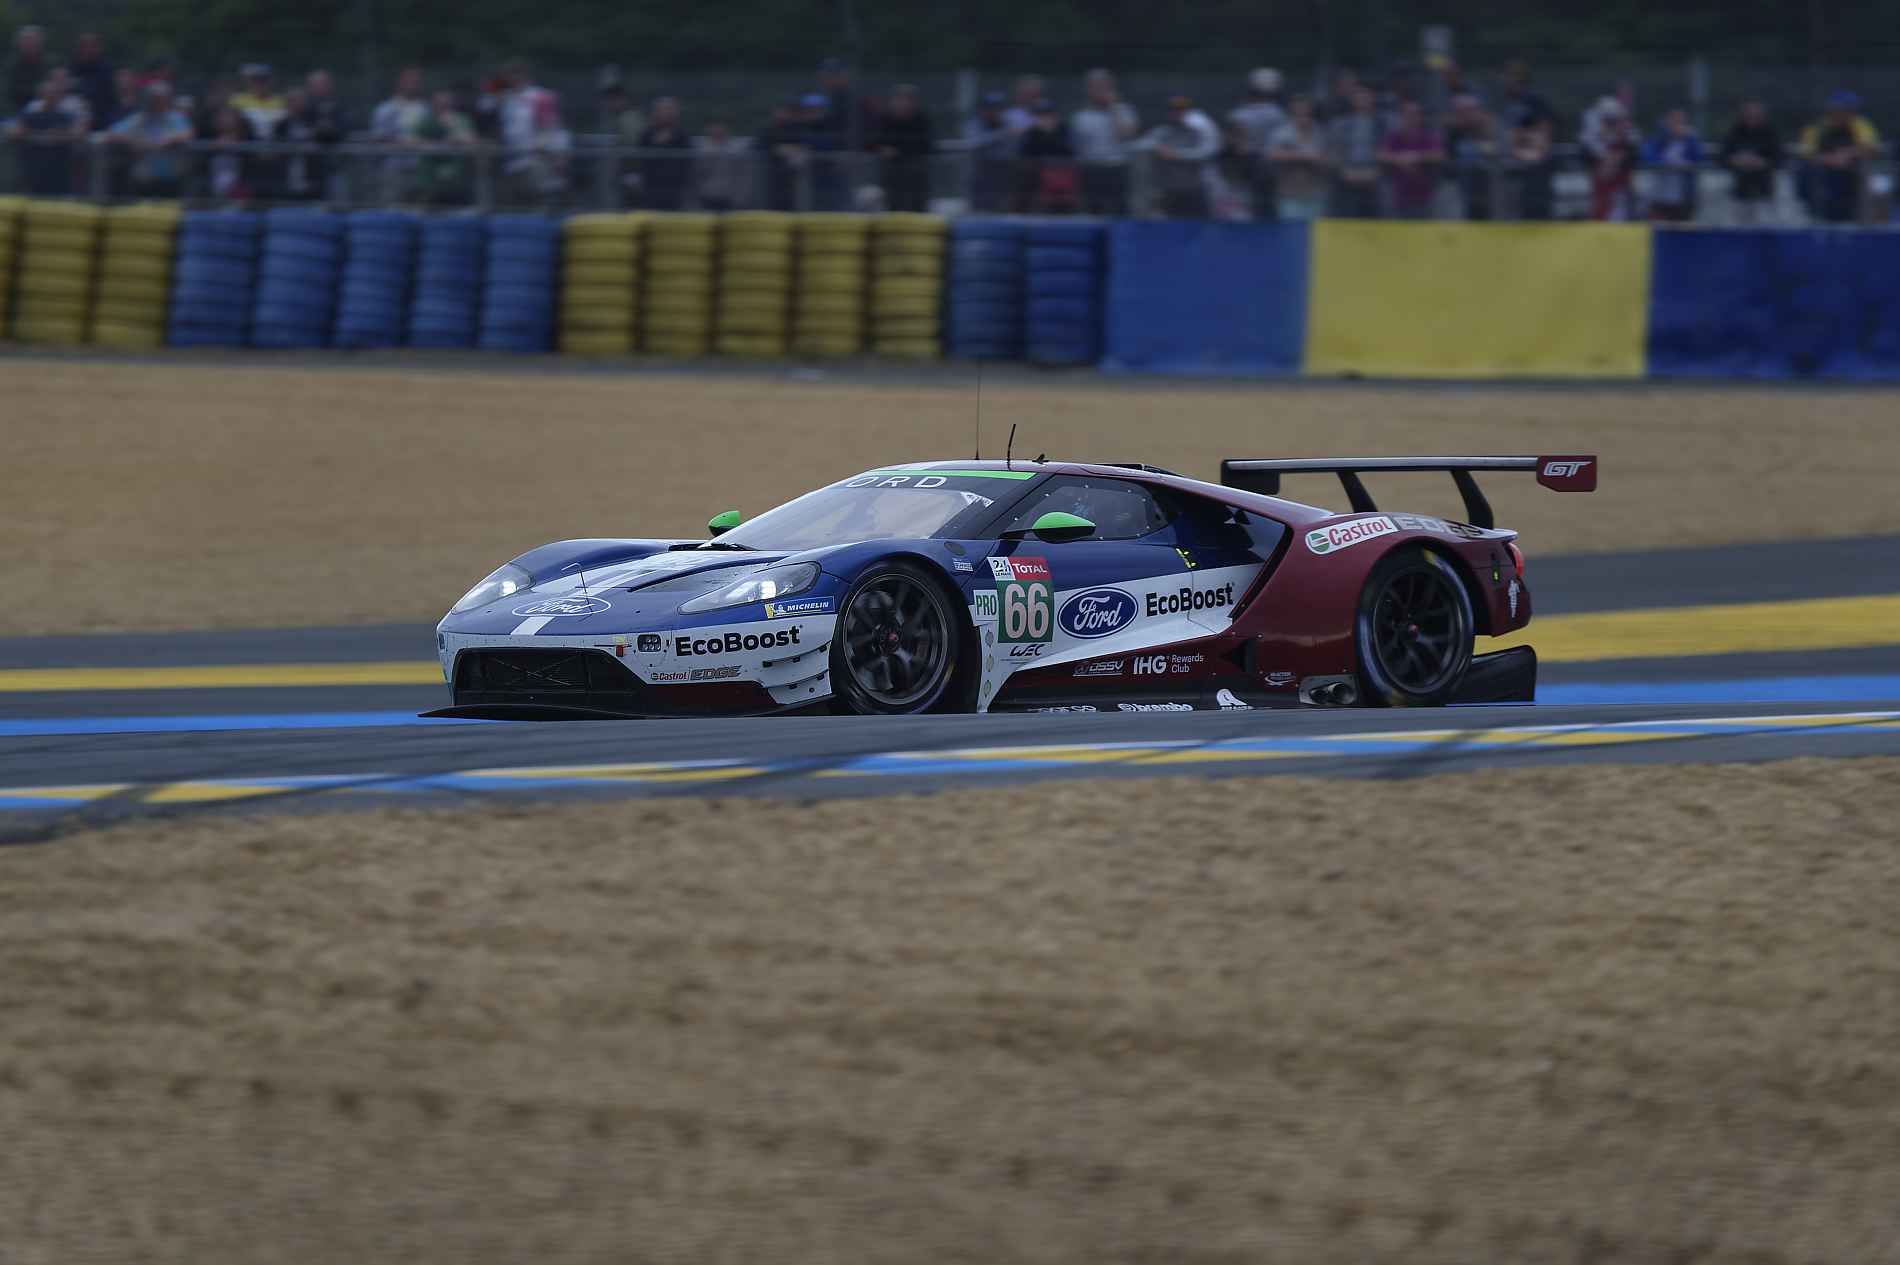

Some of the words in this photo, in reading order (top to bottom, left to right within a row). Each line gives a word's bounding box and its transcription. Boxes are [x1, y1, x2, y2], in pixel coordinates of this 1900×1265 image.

[1543, 460, 1592, 477] GT
[1328, 518, 1393, 546] Castrol
[1012, 563, 1048, 574] TOTAL
[786, 601, 830, 612] MICHELIN
[975, 594, 997, 616] PRO
[1004, 583, 1050, 638] 66
[1146, 582, 1234, 617] EcoBoost
[1073, 596, 1123, 631] Ford
[675, 625, 801, 657] EcoBoost
[1010, 643, 1045, 657] WEC
[659, 672, 688, 681] Castrol
[690, 665, 743, 681] EDGE
[1133, 655, 1168, 675] IHG
[1171, 653, 1204, 663] Rewards
[1171, 664, 1190, 673] Club
